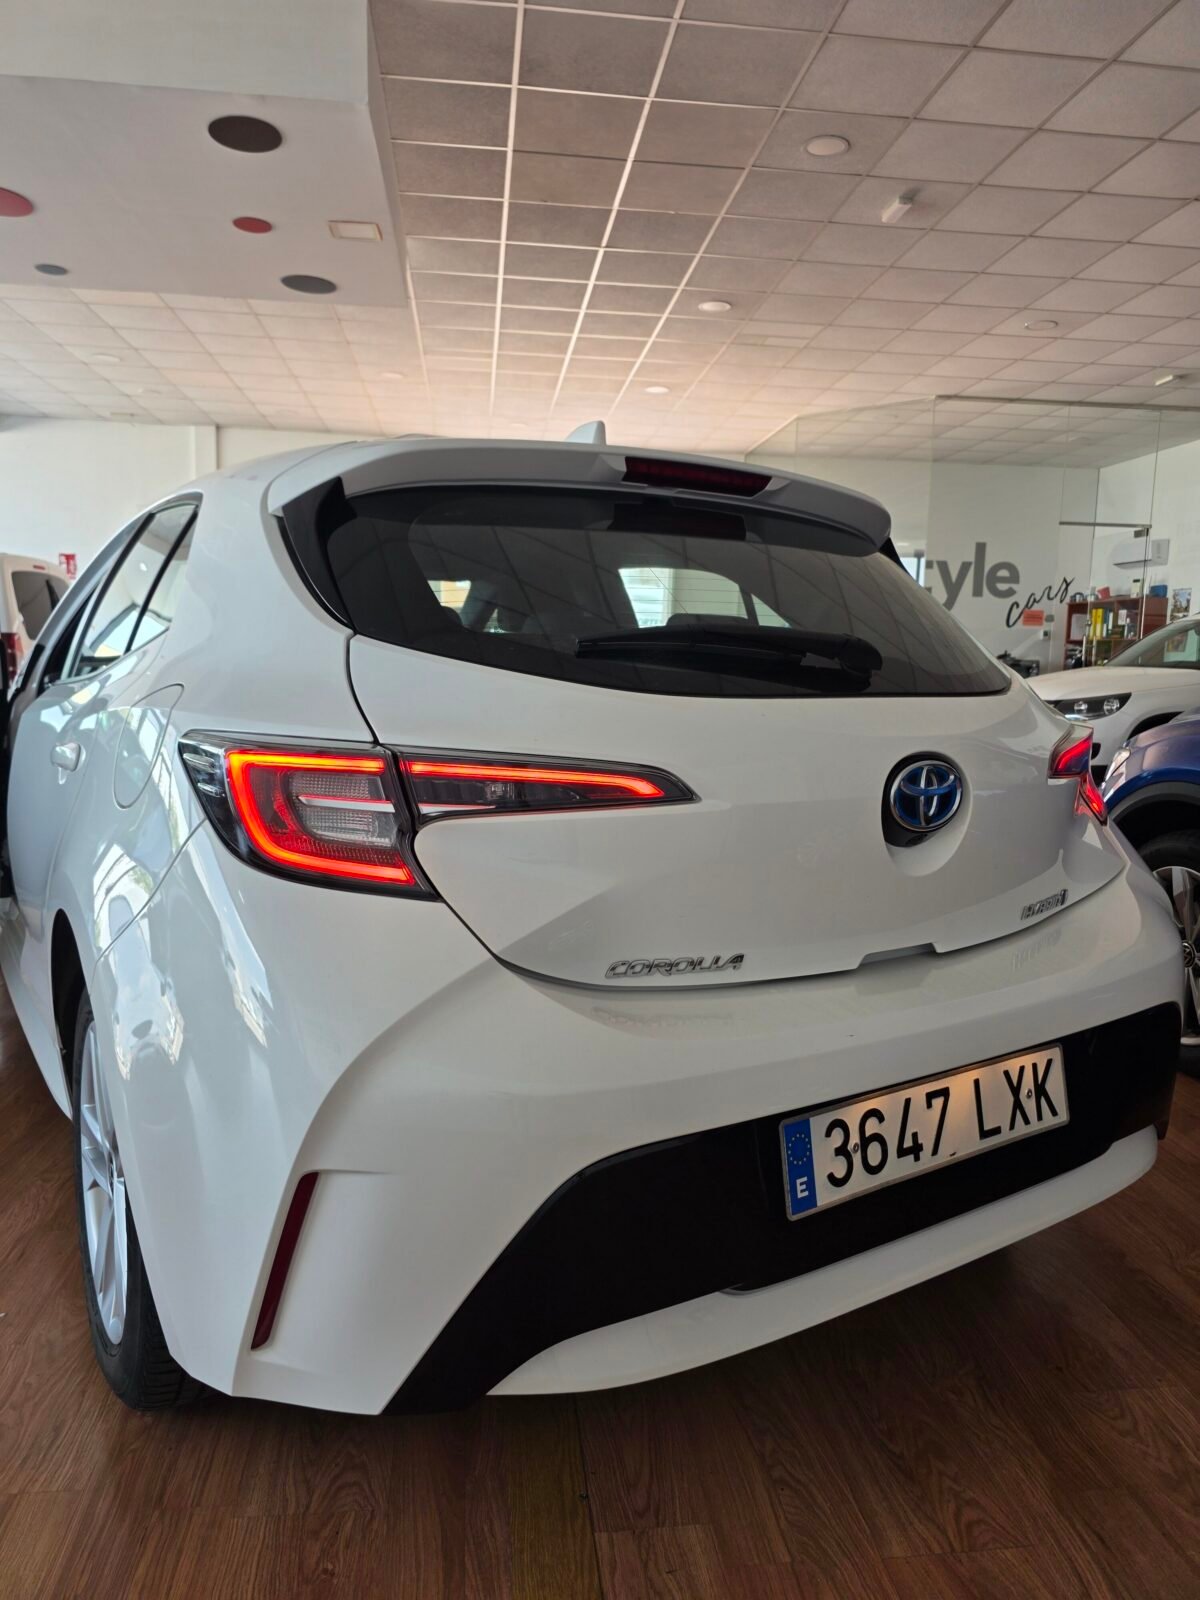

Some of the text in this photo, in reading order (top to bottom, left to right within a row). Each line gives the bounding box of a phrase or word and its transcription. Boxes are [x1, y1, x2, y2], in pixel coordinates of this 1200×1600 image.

[1005, 576, 1075, 629] cars
[605, 953, 745, 979] COROLLA
[824, 1058, 1059, 1188] 3647 LXK
[796, 1176, 809, 1199] E
